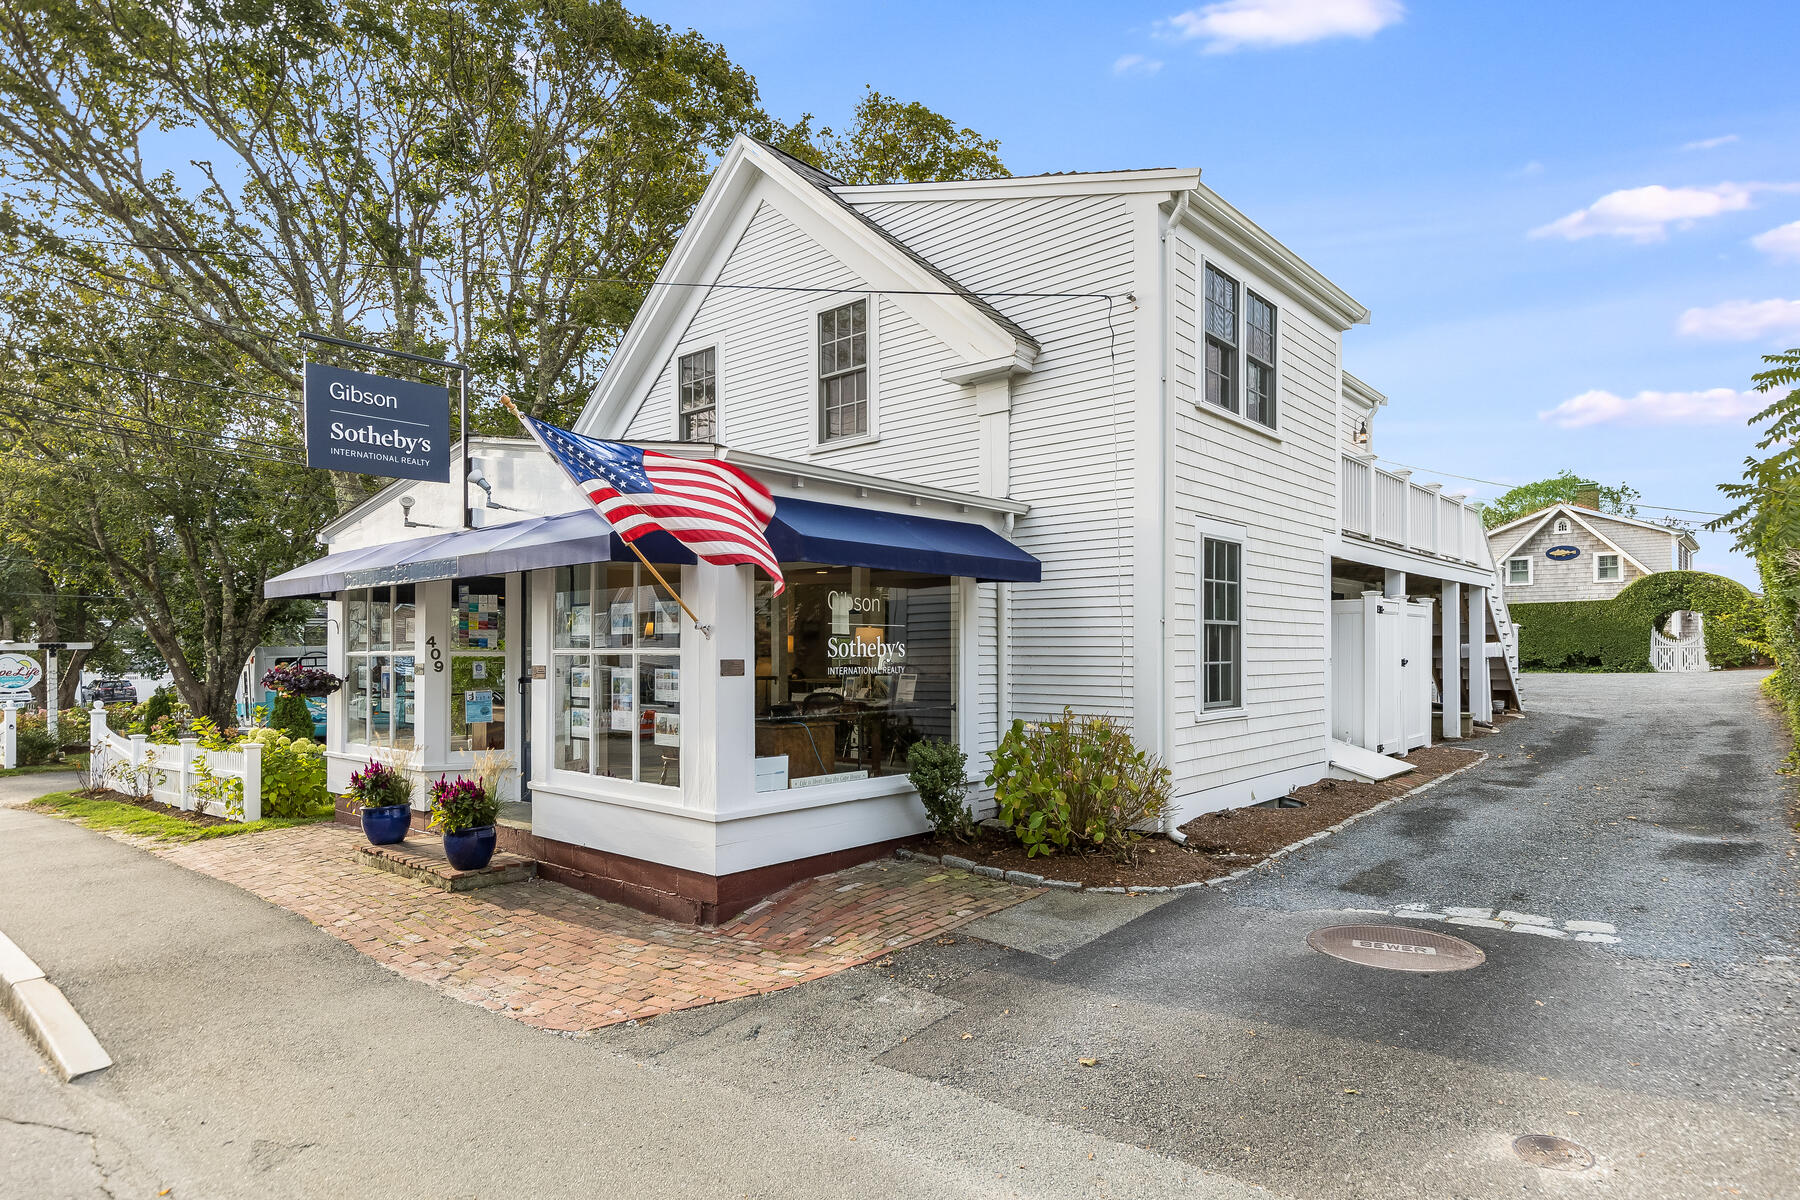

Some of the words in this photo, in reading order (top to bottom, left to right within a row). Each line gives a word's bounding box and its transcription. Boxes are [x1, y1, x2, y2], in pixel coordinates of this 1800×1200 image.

[329, 382, 398, 409] Gibson
[330, 422, 431, 454] Sotheby's
[330, 447, 399, 463] INTERNATIONAL
[401, 457, 430, 467] REALTY
[828, 590, 880, 612] Gbson
[827, 636, 906, 662] Sotheby's
[827, 666, 880, 675] INTERNATIONAL
[882, 666, 905, 674] REALTY
[1360, 941, 1427, 953] SEWER
